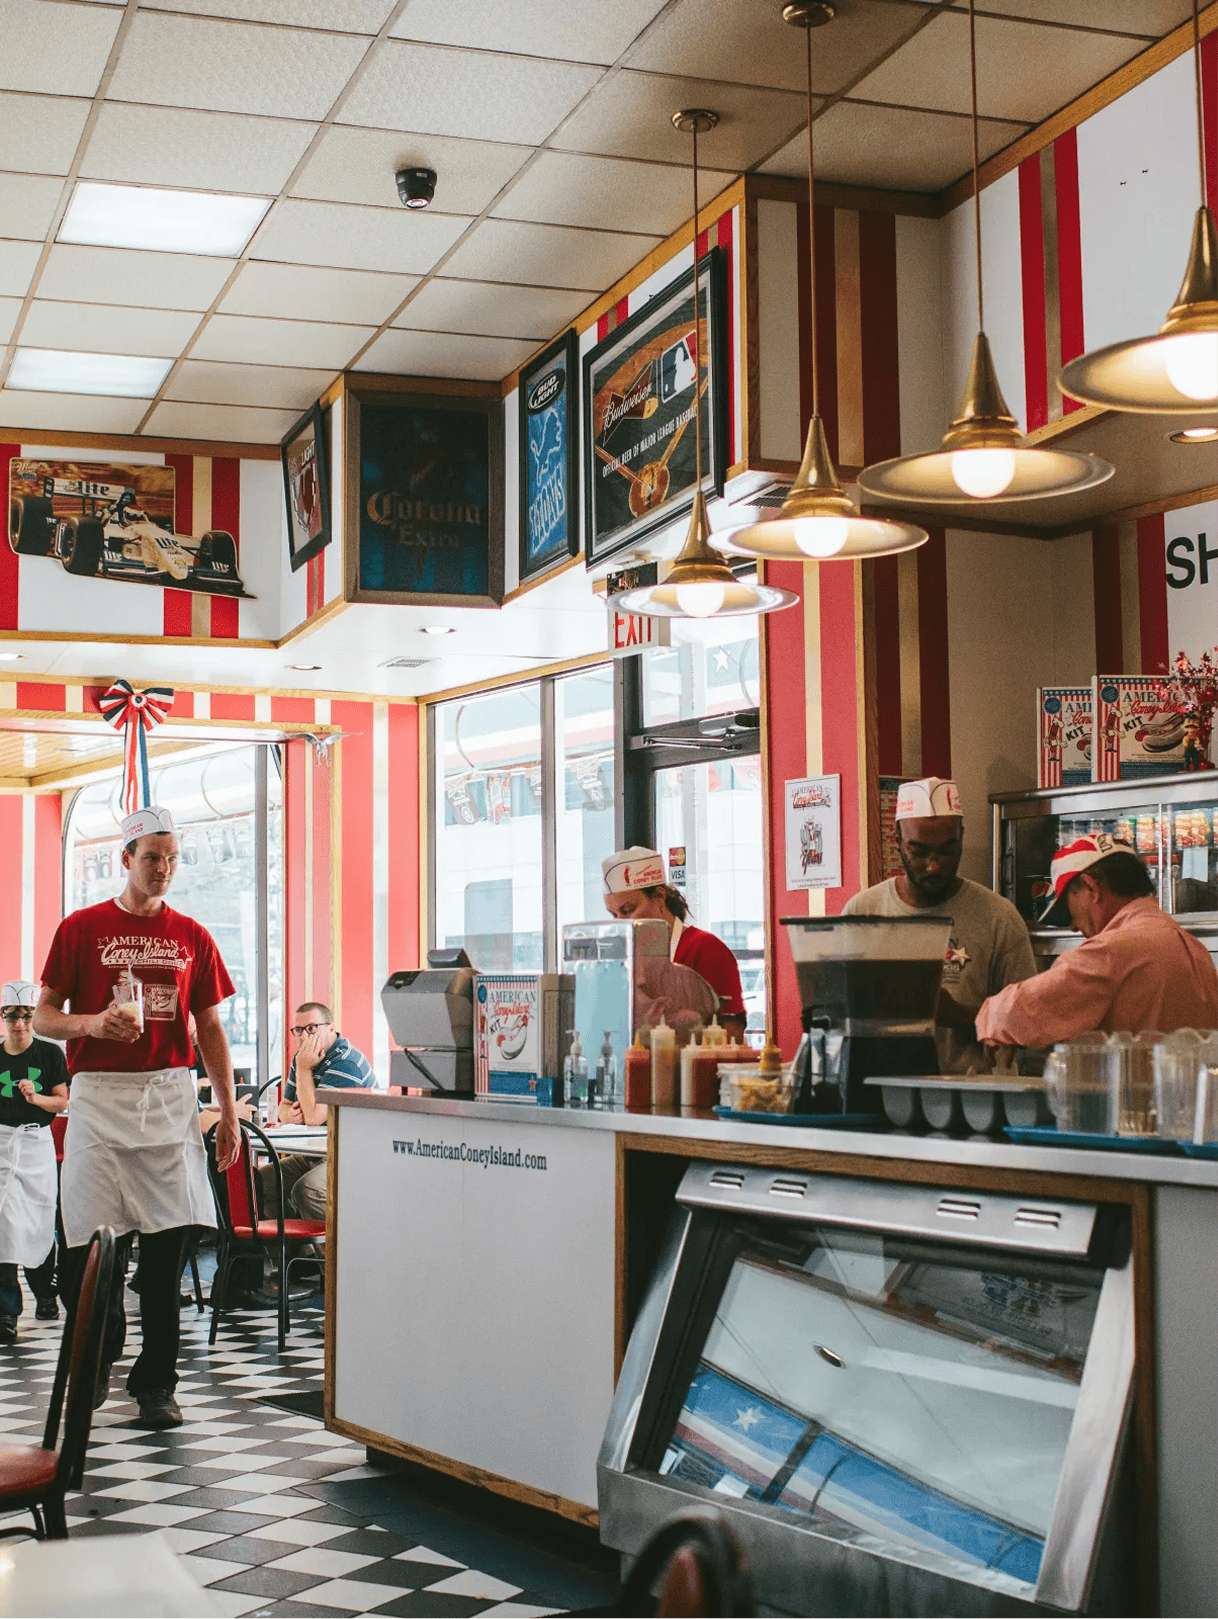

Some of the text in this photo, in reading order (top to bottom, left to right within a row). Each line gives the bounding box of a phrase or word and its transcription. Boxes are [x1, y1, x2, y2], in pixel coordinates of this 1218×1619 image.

[533, 380, 560, 407] LIGHT
[537, 374, 557, 396] BUD
[602, 382, 652, 430] Budweiser
[621, 448, 632, 465] BEER
[633, 443, 640, 458] OF
[640, 432, 656, 453] MAJOR
[656, 419, 675, 441] LEAGUE
[366, 491, 482, 529] Corona
[1065, 725, 1085, 741] KIT
[1123, 716, 1143, 731] KIT
[671, 870, 685, 879] VISA
[111, 936, 179, 947] AMERICAN
[101, 942, 179, 966] Coney Island
[490, 990, 537, 1003] AMERICAN
[490, 1018, 501, 1035] KIT
[392, 1138, 548, 1170] www.AmericanConeyIsland.com
